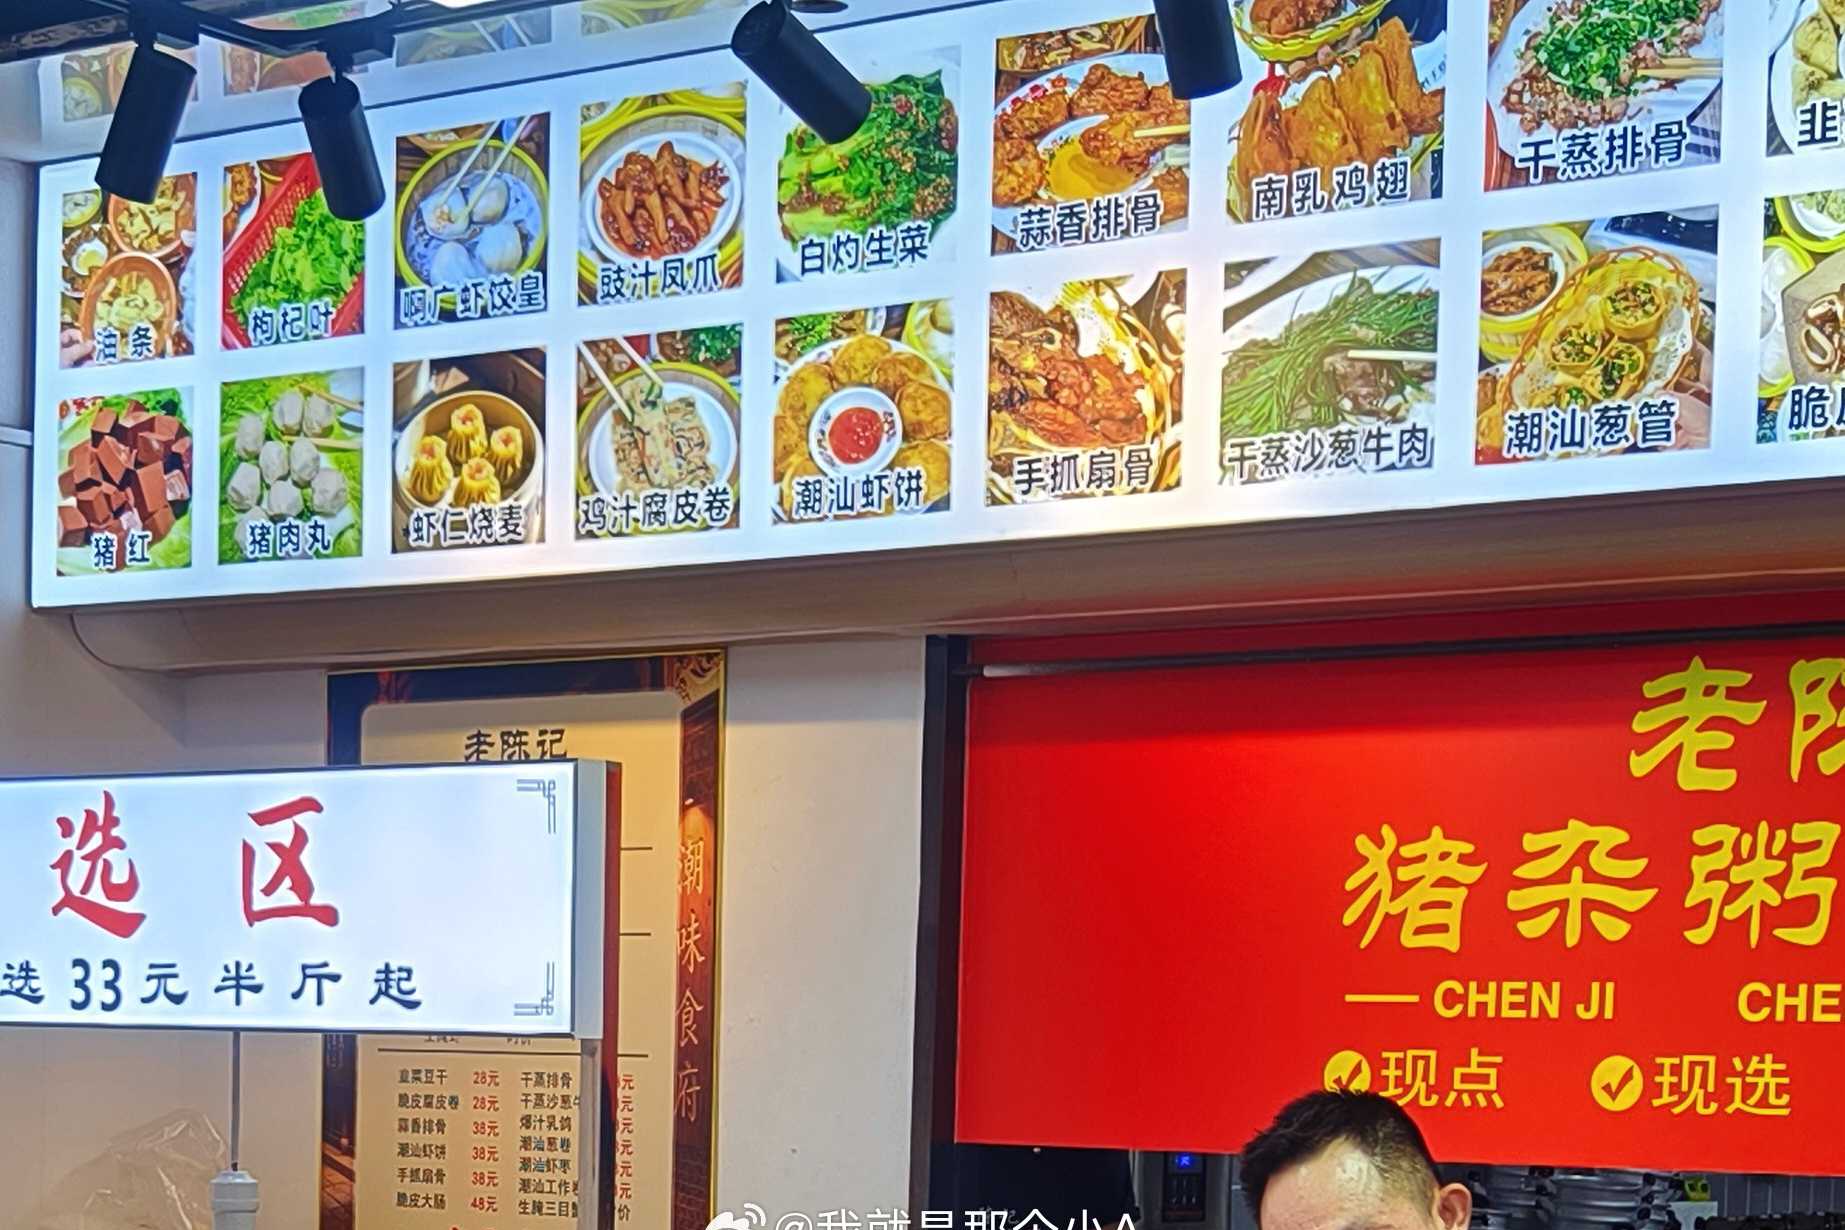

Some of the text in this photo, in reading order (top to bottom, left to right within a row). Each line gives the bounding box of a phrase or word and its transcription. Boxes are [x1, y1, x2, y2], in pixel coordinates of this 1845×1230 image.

[1516, 119, 1688, 183] 干蒸排骨
[1254, 160, 1409, 217] 南乳鸡翅
[1019, 193, 1161, 248] 蒜香排骨
[799, 226, 929, 274] 白灼生菜
[599, 253, 720, 300] 豉汁凤爪
[95, 326, 154, 363] 油条
[252, 306, 333, 342] 枸杞叶
[1506, 399, 1677, 455] 潮汕葱管
[1788, 386, 1845, 430] 脆
[1014, 450, 1154, 496] 手抓扇骨
[1227, 422, 1433, 480] 干蒸沙葱牛肉
[579, 487, 731, 532] 鸡汁腐皮卷
[794, 471, 924, 515] 潮汕虾饼
[248, 523, 332, 555] 猪肉丸
[410, 508, 523, 546] 虾仁烧麦
[94, 532, 150, 567] 猪红
[1342, 819, 1840, 953] 猪杂粥
[676, 839, 706, 1122] 潮味食府
[1433, 980, 1560, 1019] CHEN
[1576, 981, 1615, 1020] JI
[473, 1070, 500, 1087] 28元
[1380, 1046, 1792, 1115] 现点 现选
[473, 1095, 500, 1112] 28元
[472, 1146, 499, 1162] 38元
[472, 1171, 499, 1187] 38元
[471, 1196, 498, 1213] 48元
